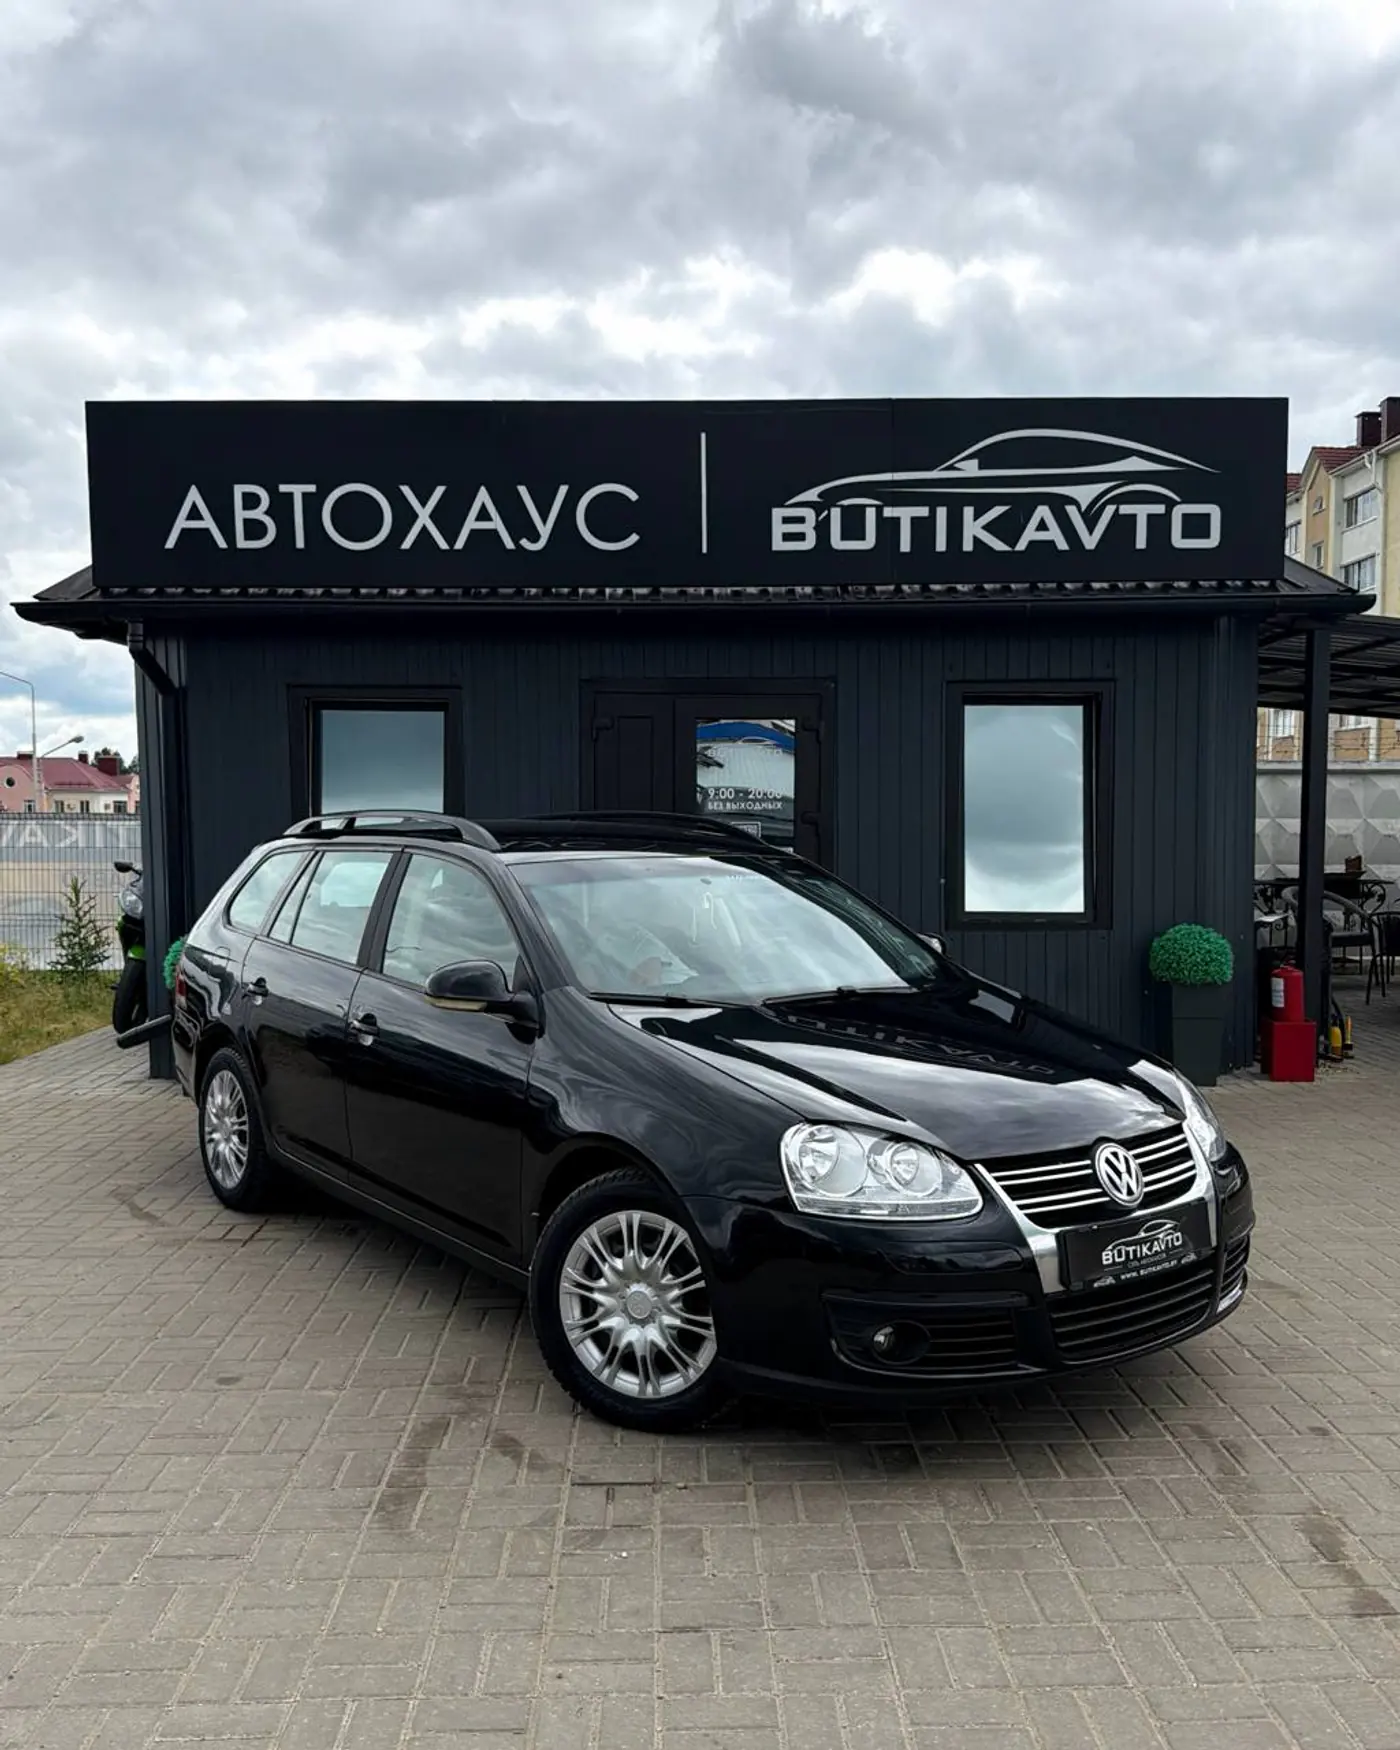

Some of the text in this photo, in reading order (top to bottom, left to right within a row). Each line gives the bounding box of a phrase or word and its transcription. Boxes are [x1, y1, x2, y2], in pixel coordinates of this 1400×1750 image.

[165, 482, 640, 552] АВТОХАУС
[771, 503, 1221, 553] BUTIKAVTO
[708, 788, 735, 799] 9:00
[1101, 1232, 1183, 1265] BUTIKAVTO
